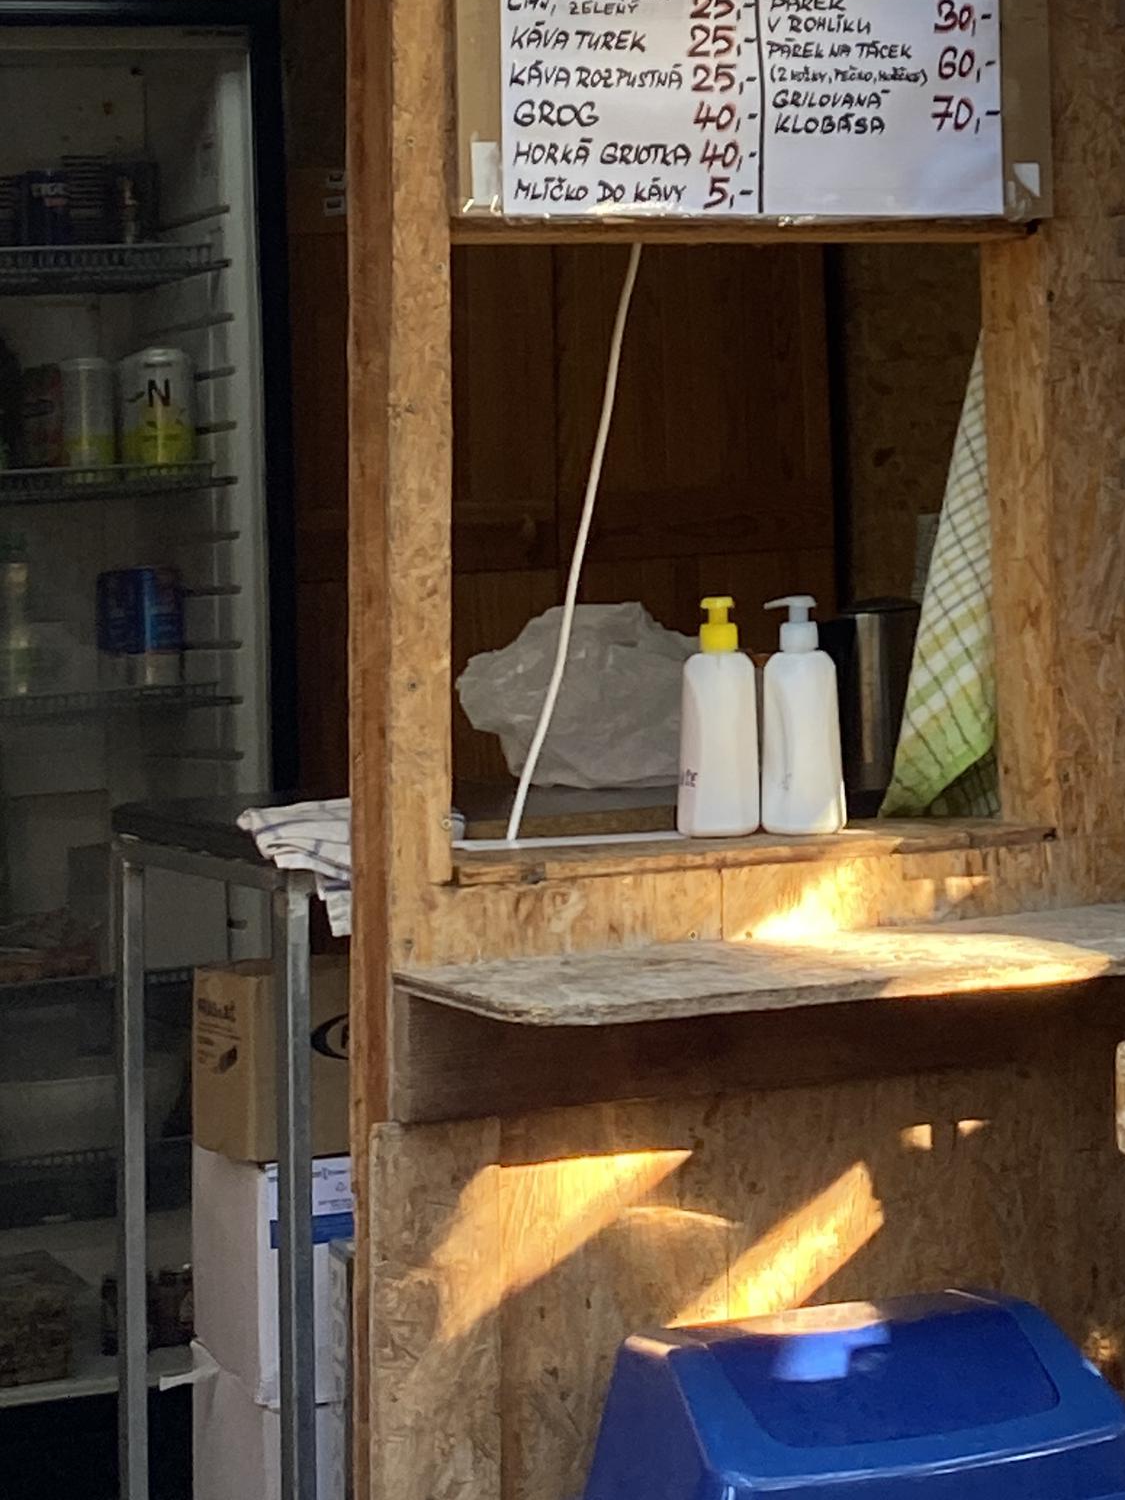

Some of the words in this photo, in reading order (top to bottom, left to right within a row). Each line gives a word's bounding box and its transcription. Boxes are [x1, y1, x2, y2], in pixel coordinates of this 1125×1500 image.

[569, 0, 639, 15] ZELENÝ
[510, 21, 568, 50] KÁVA
[575, 30, 647, 52] TUREK
[768, 17, 780, 32] V
[510, 60, 570, 87] KÁVA
[576, 64, 682, 89] ROZPUSTNÁ
[513, 100, 599, 127] GROG
[774, 113, 885, 134] KLOBÁSA
[513, 138, 593, 166] HORKÁ
[597, 180, 625, 202] DO
[634, 178, 687, 203] KÁVY
